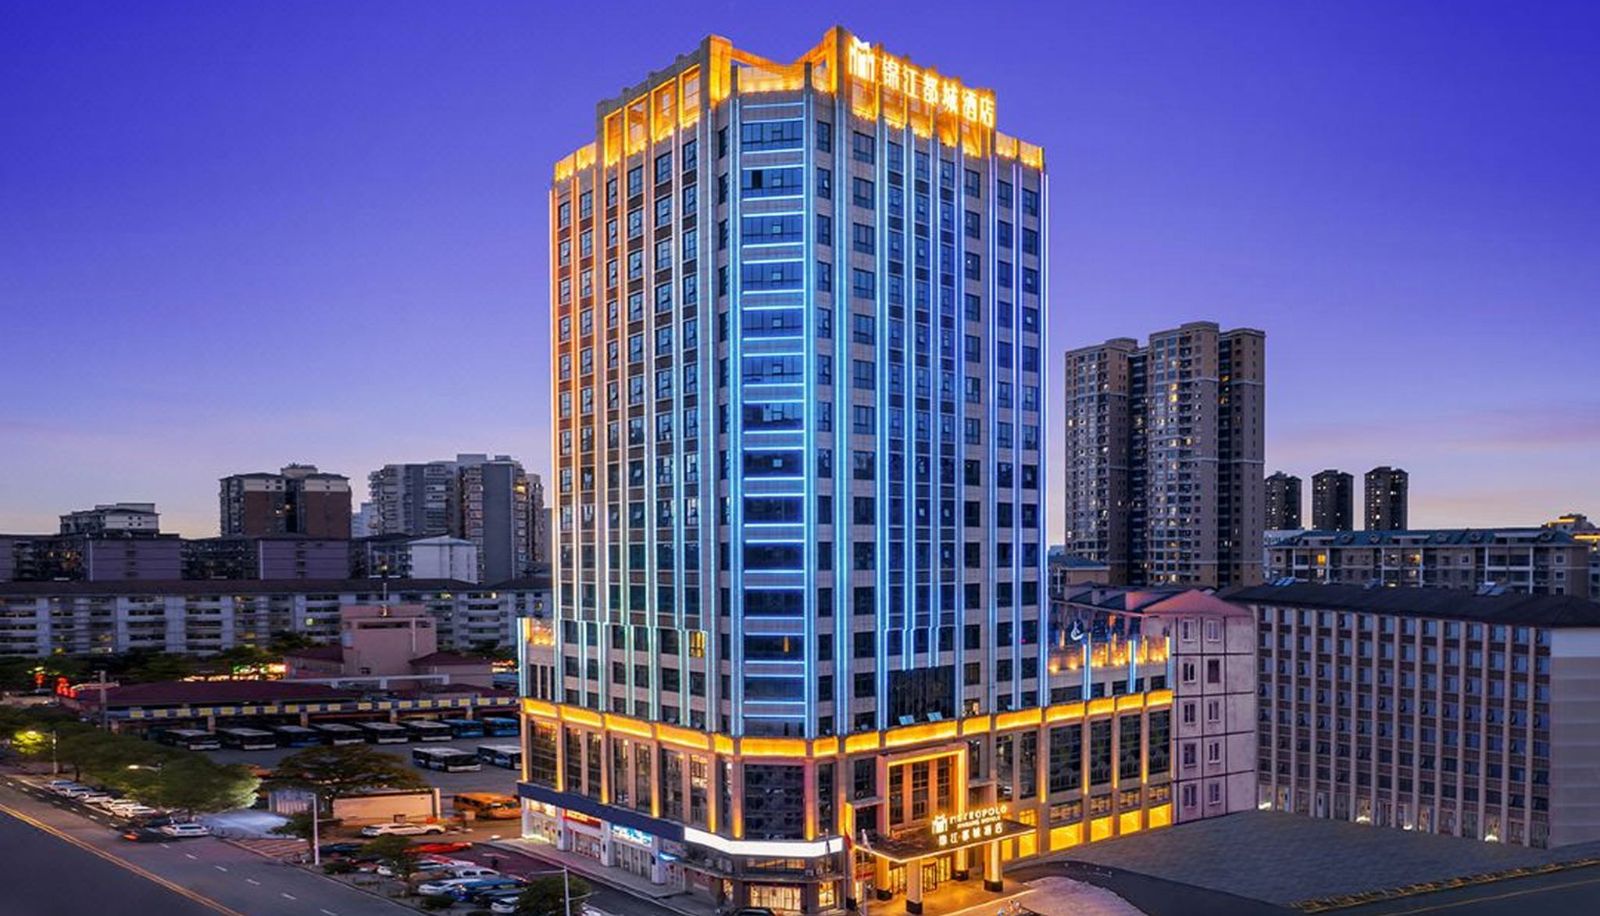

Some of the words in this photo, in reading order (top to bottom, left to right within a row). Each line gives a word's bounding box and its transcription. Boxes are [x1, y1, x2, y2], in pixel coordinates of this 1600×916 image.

[882, 55, 995, 128] 锦江都城酒店
